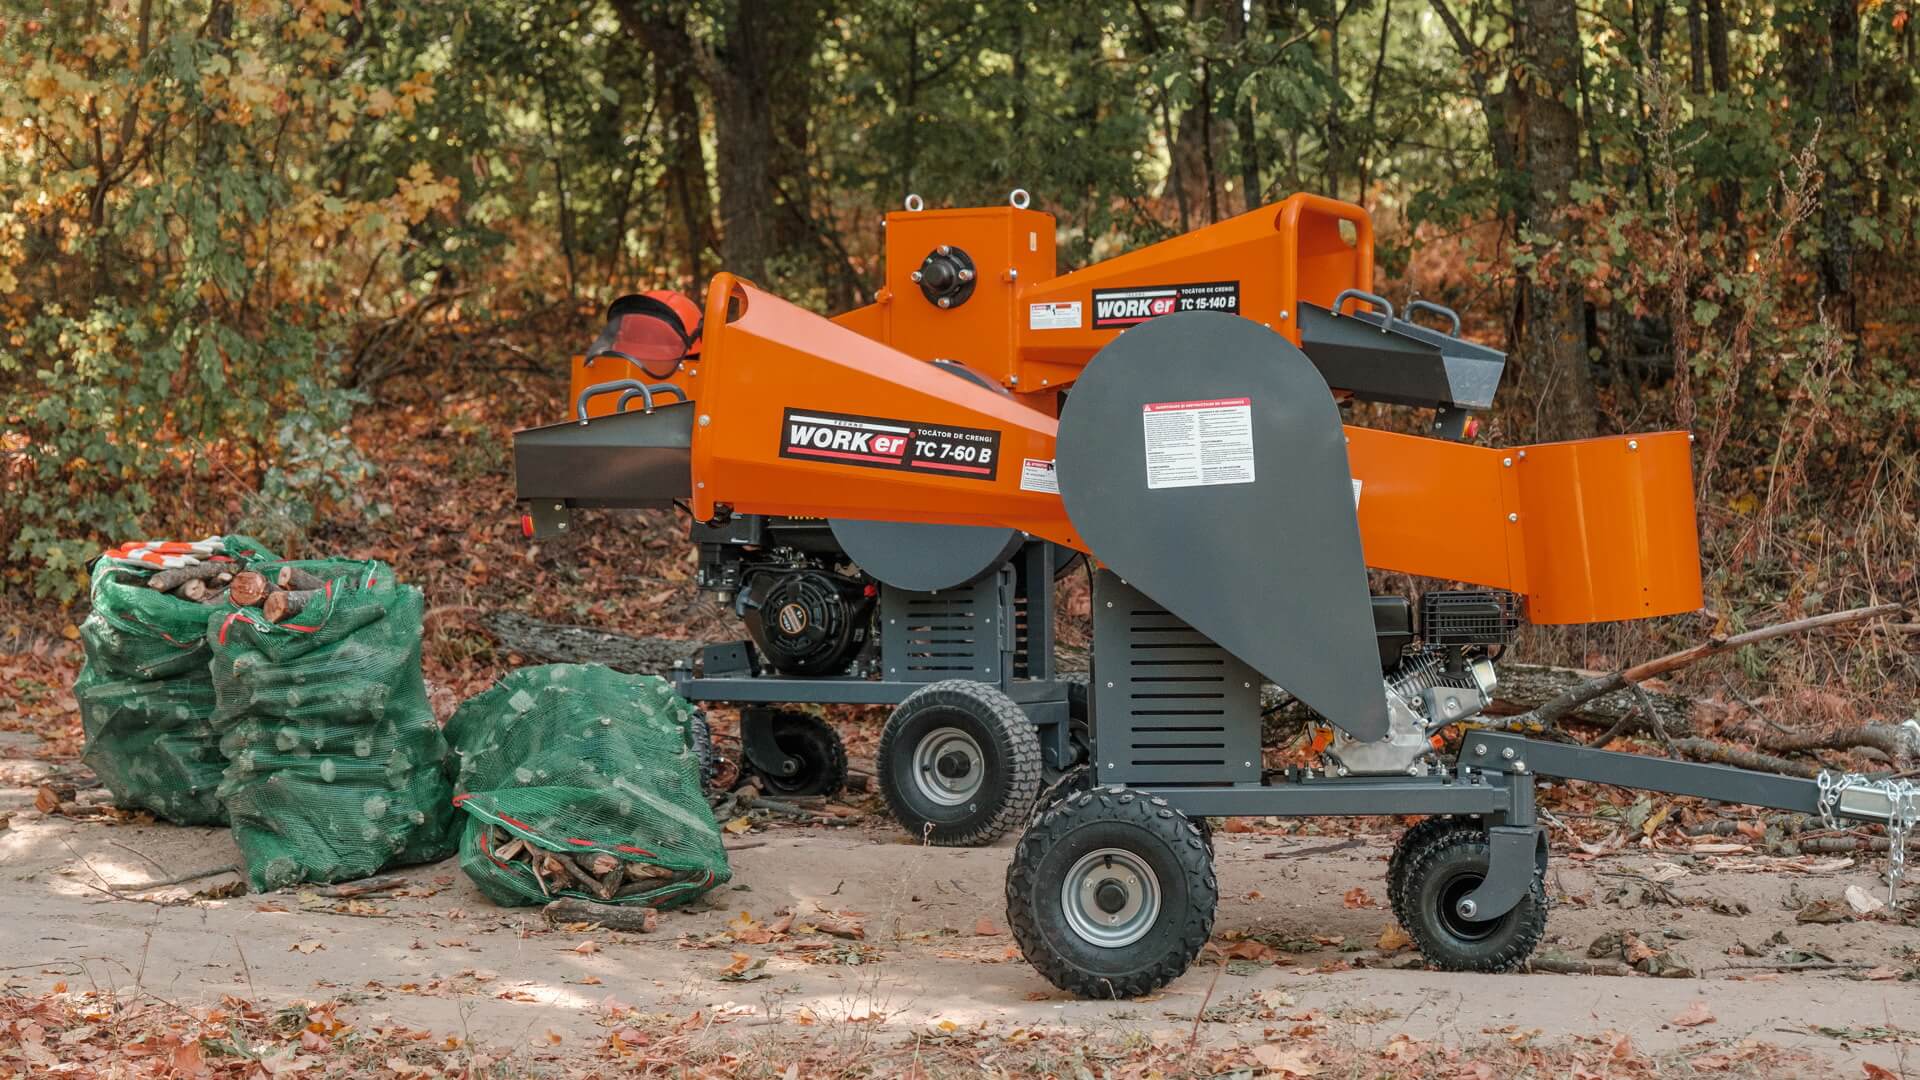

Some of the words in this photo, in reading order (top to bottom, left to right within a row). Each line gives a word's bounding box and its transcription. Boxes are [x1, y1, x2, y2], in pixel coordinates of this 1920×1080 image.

[1181, 298, 1194, 311] TC
[1195, 296, 1227, 310] 15-140
[1228, 295, 1236, 308] B
[953, 432, 964, 440] DE
[965, 433, 993, 443] CRENGI
[915, 440, 938, 458] TC
[940, 443, 976, 461] 7-60
[978, 447, 992, 463] B
